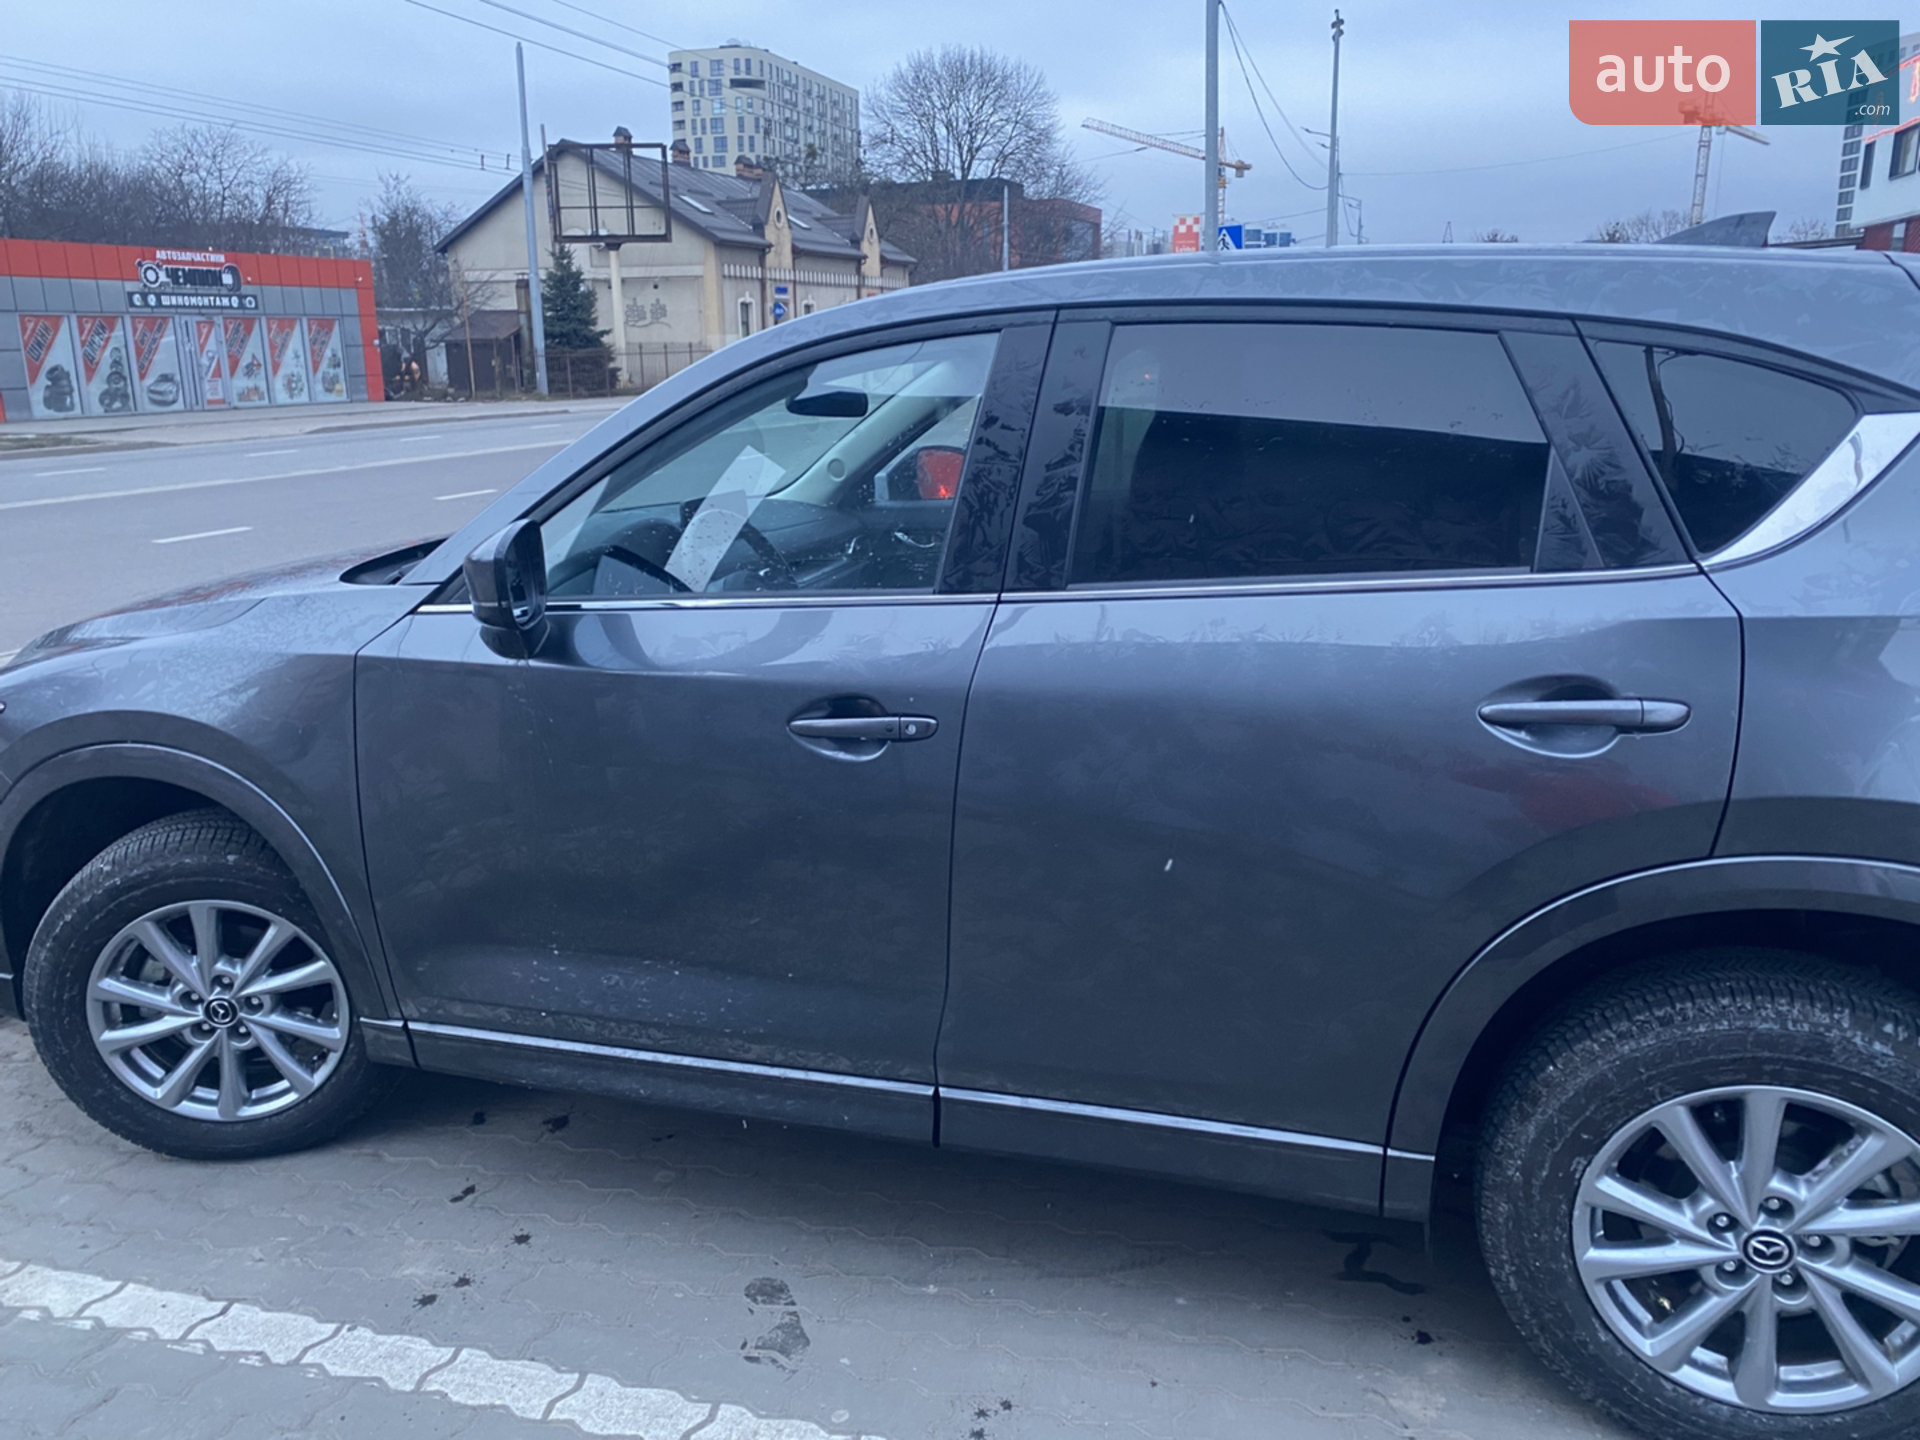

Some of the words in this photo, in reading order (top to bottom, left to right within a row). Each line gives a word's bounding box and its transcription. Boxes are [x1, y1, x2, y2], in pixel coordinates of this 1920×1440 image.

[161, 295, 230, 307] ШИНОМОНТАЖ
[26, 319, 53, 363] ШИНИ
[82, 318, 109, 367] ДИСКИ
